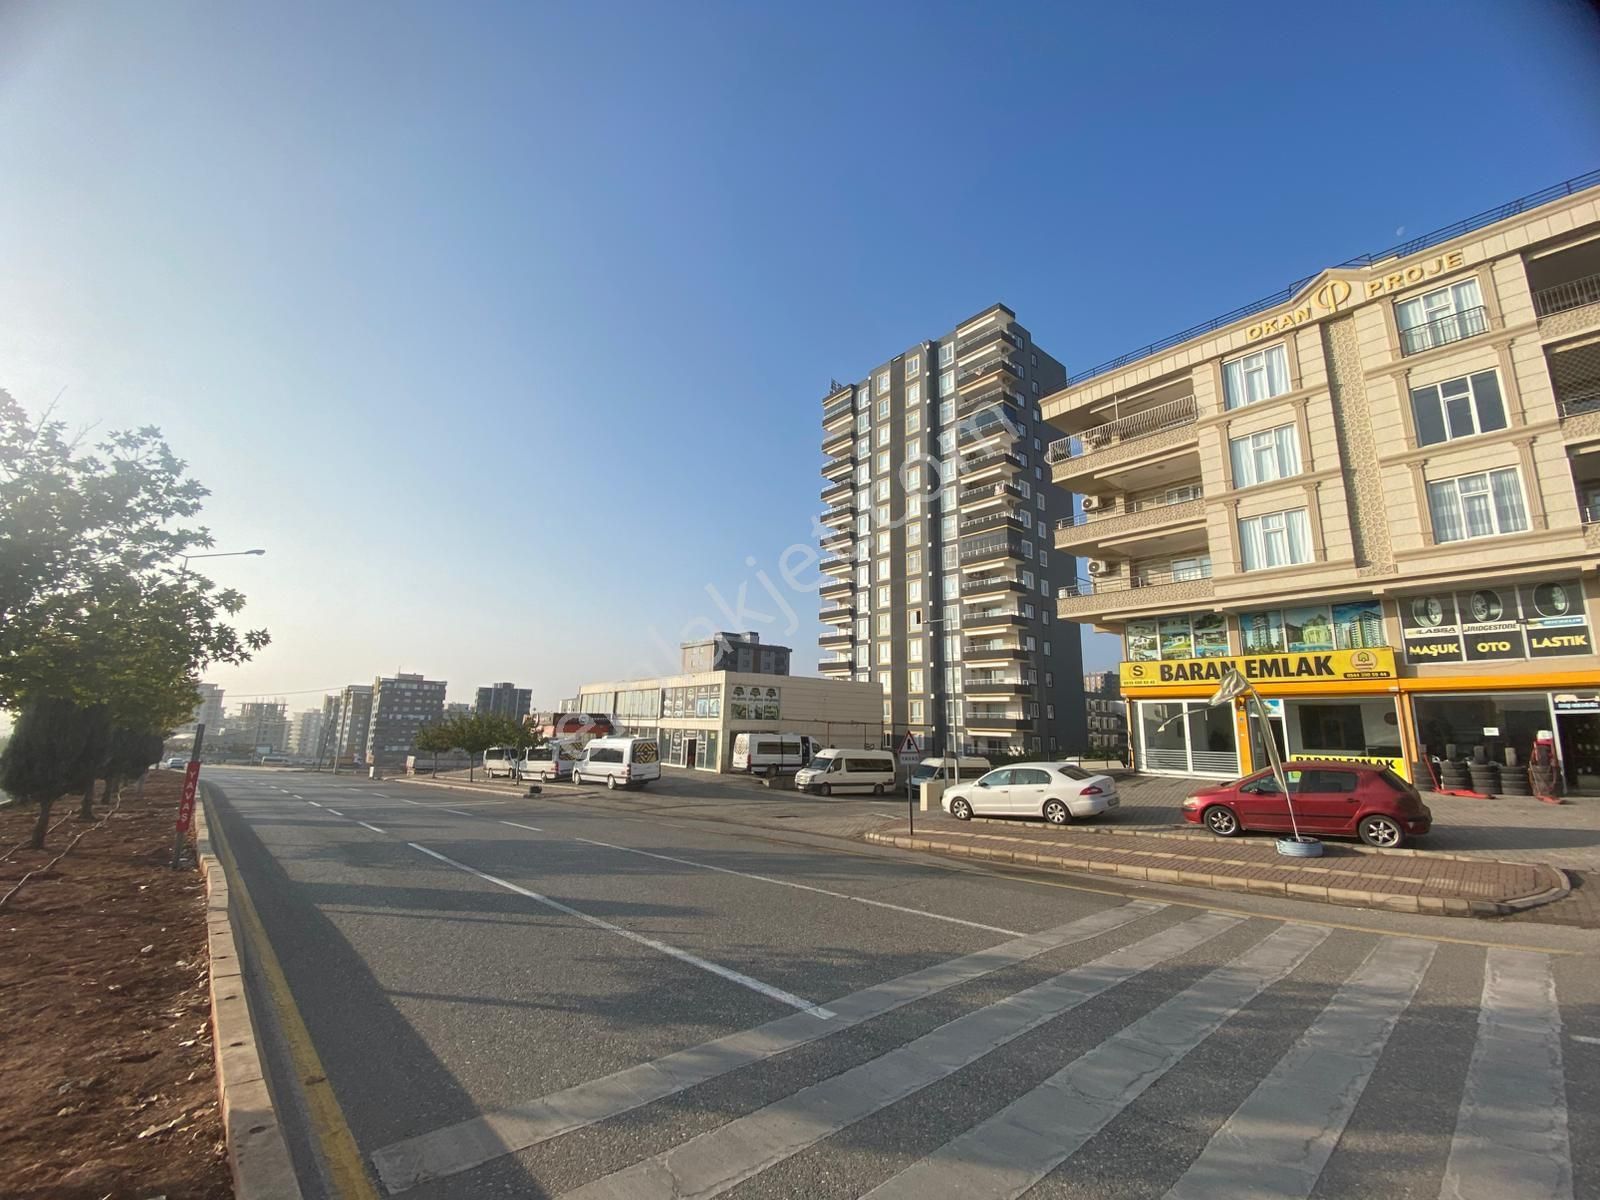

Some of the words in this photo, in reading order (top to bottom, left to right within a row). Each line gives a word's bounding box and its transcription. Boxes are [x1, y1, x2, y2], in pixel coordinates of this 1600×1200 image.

[1246, 307, 1311, 341] OKAN
[1366, 250, 1463, 299] PROJE
[1476, 641, 1511, 653] OTO
[1132, 664, 1144, 677] S
[1160, 660, 1237, 682] BARAN
[1246, 655, 1335, 679] EMLAK
